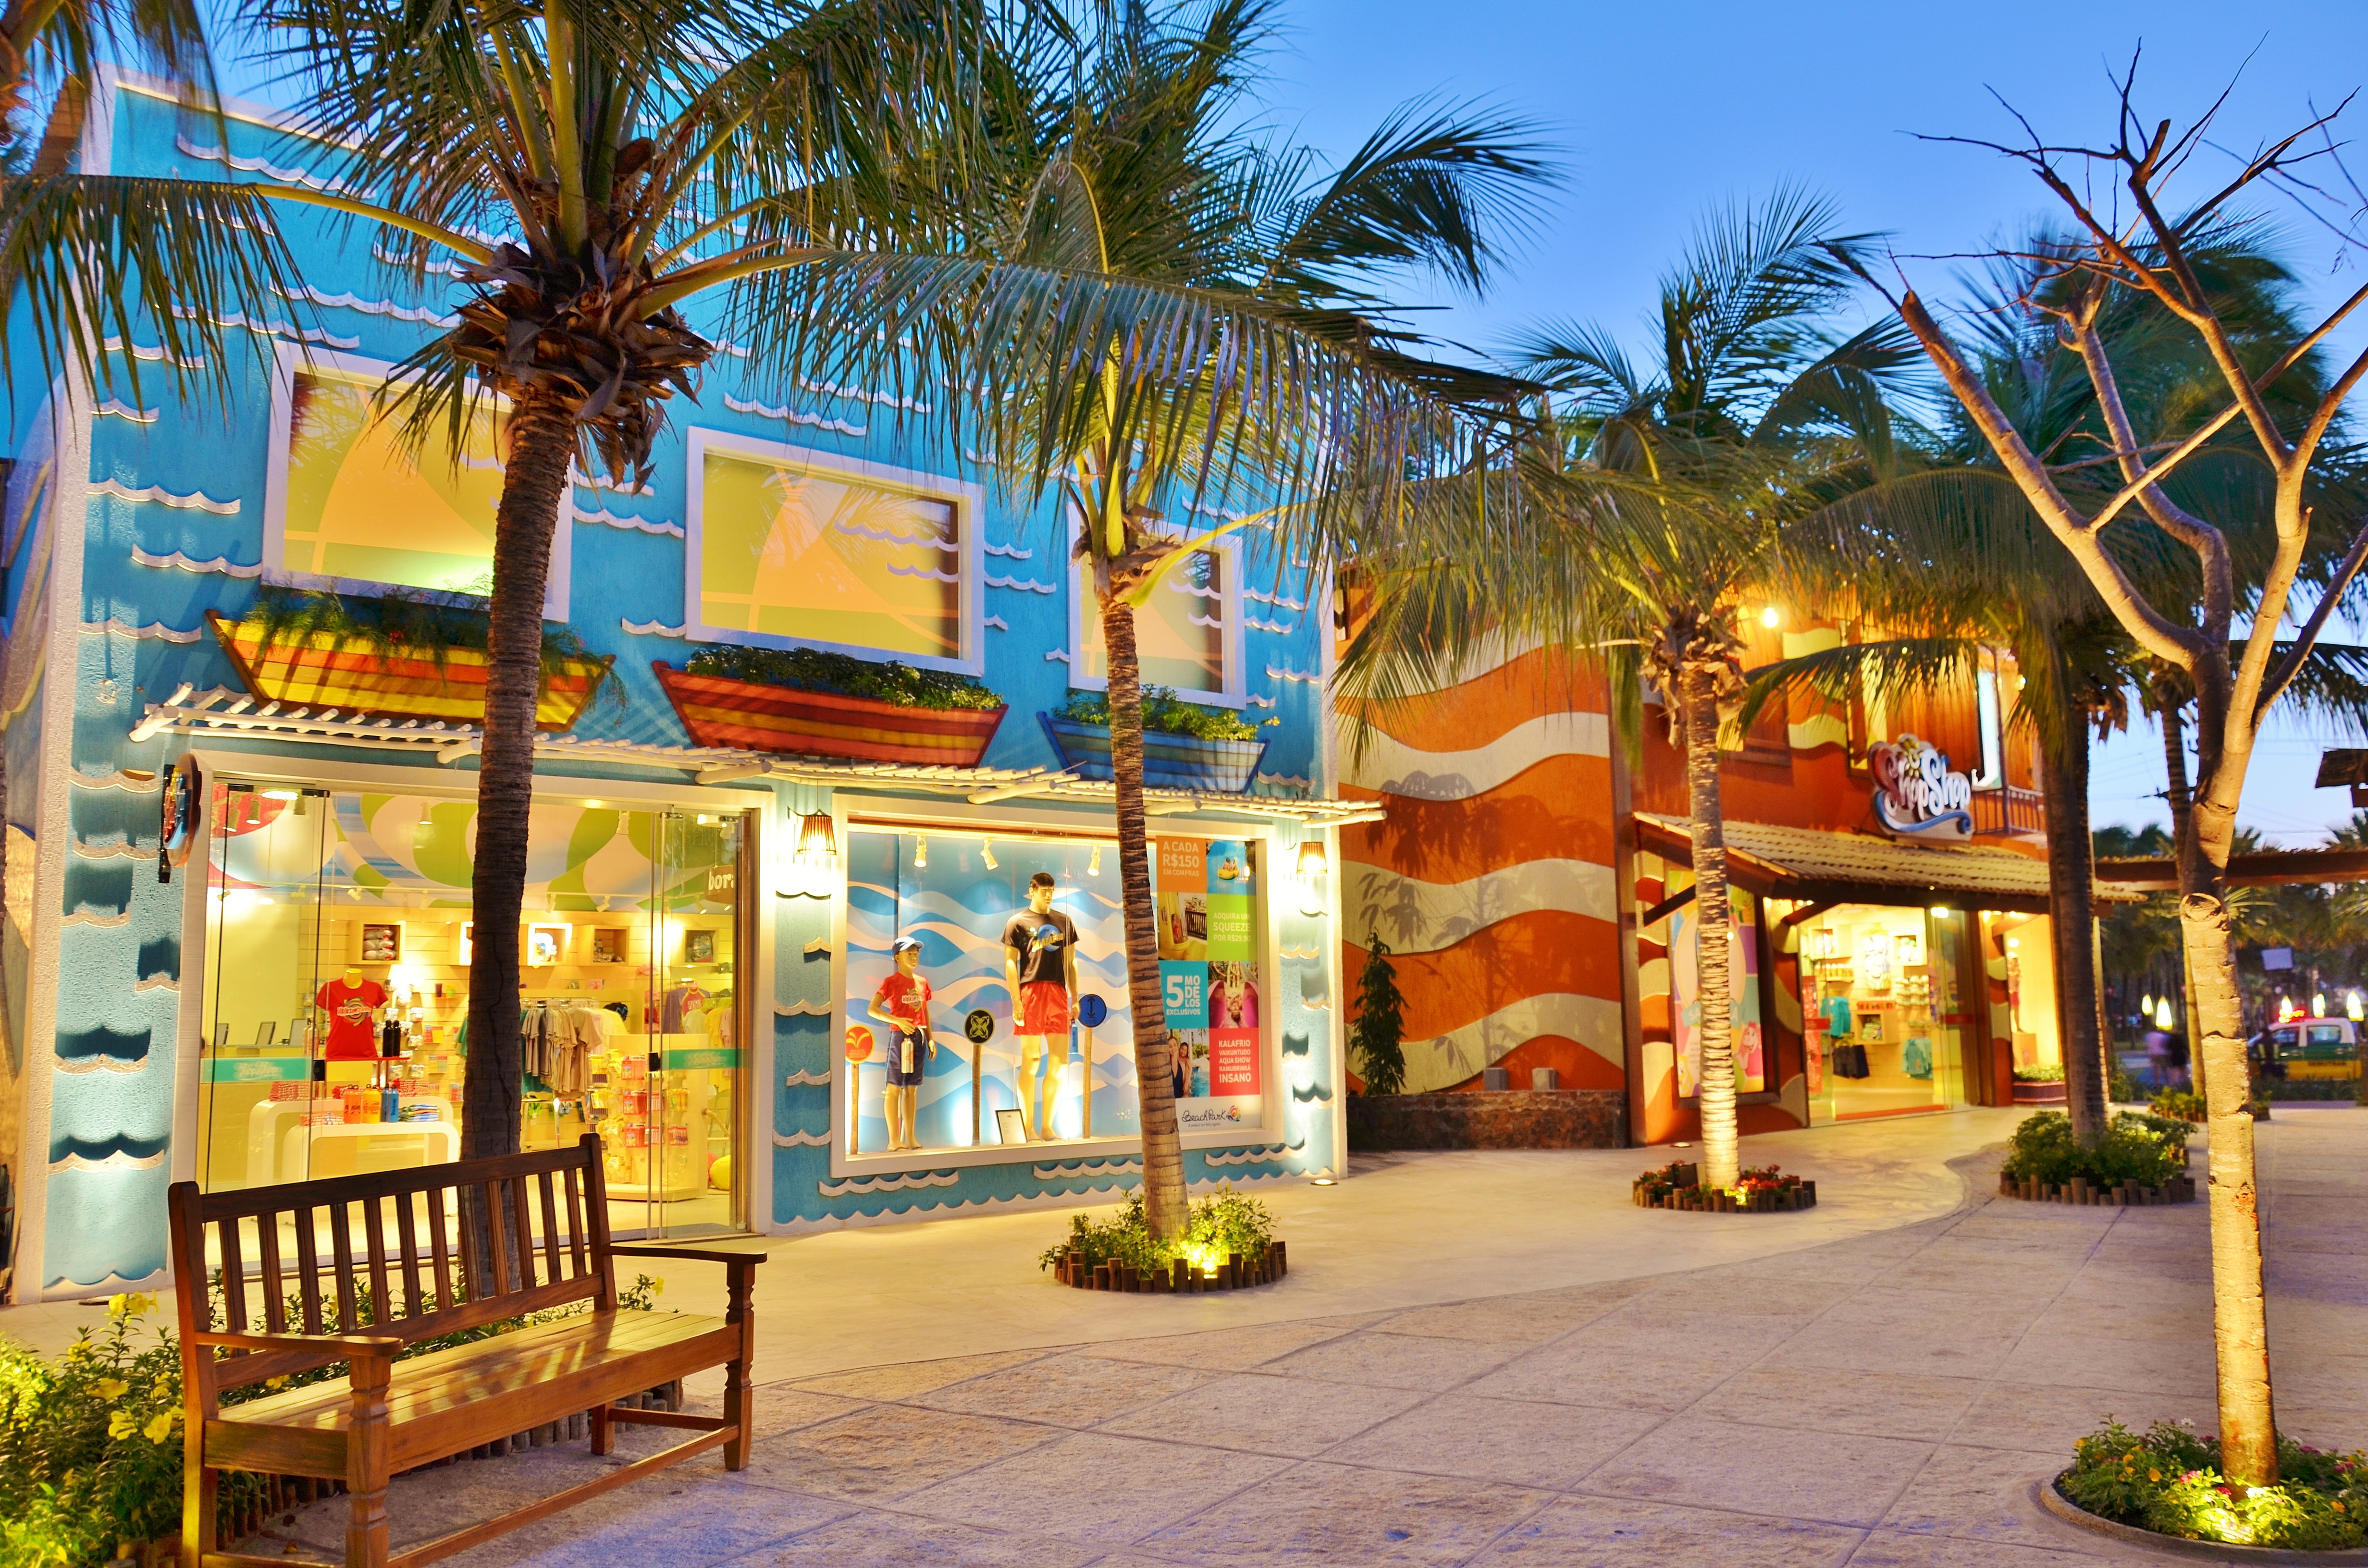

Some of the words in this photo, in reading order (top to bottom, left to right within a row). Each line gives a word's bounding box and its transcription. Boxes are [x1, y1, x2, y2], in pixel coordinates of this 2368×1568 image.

[1163, 841, 1170, 851] A
[1172, 842, 1199, 853] CADA
[1163, 853, 1199, 868] R$150
[1213, 922, 1250, 932] SQUEEZE
[1227, 934, 1251, 943] R$29,90
[1184, 975, 1200, 985] MO
[1166, 975, 1184, 1007] 5
[1184, 986, 1200, 998] DE
[1185, 999, 1200, 1007] LOS
[1219, 1073, 1251, 1083] INSANO
